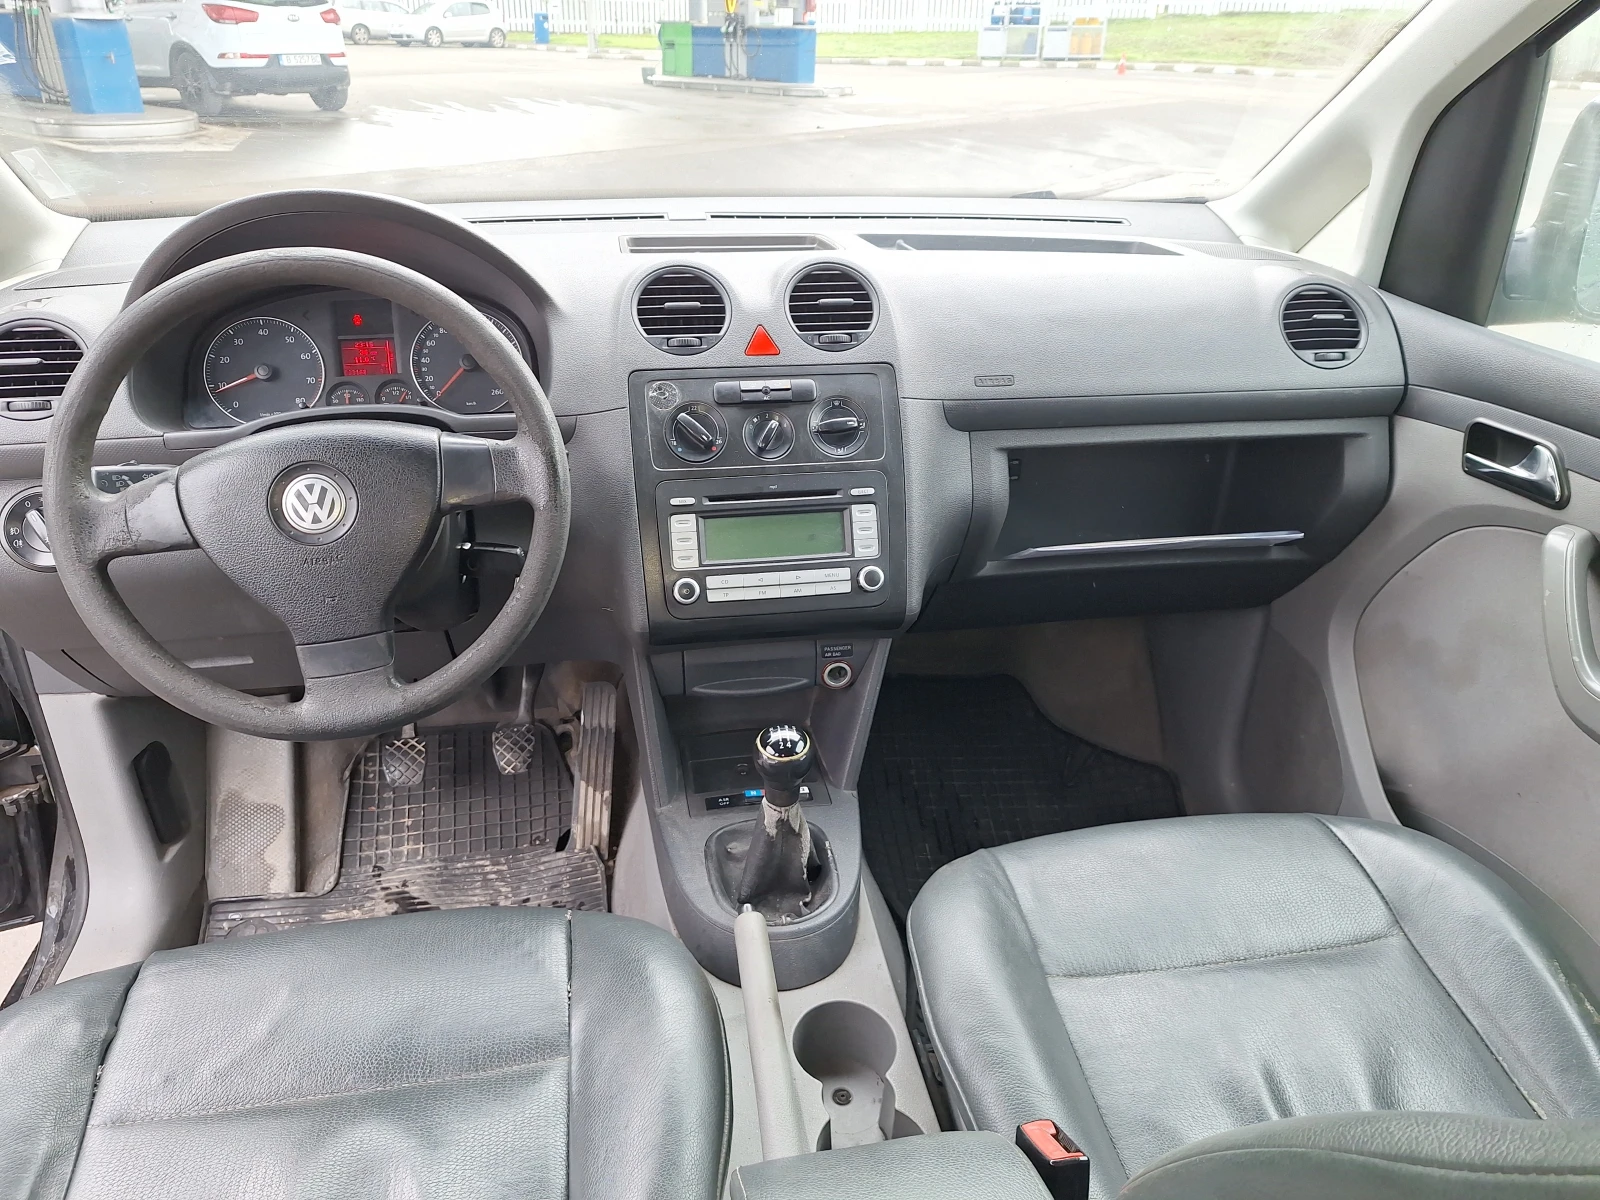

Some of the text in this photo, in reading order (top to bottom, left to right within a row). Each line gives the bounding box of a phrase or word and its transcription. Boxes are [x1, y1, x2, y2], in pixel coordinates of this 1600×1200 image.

[258, 328, 269, 336] 40
[233, 338, 244, 346] 30
[219, 356, 230, 364] 20
[300, 352, 311, 360] 60
[421, 356, 430, 364] 40
[306, 376, 316, 384] 70
[302, 553, 344, 567] AIRBAG
